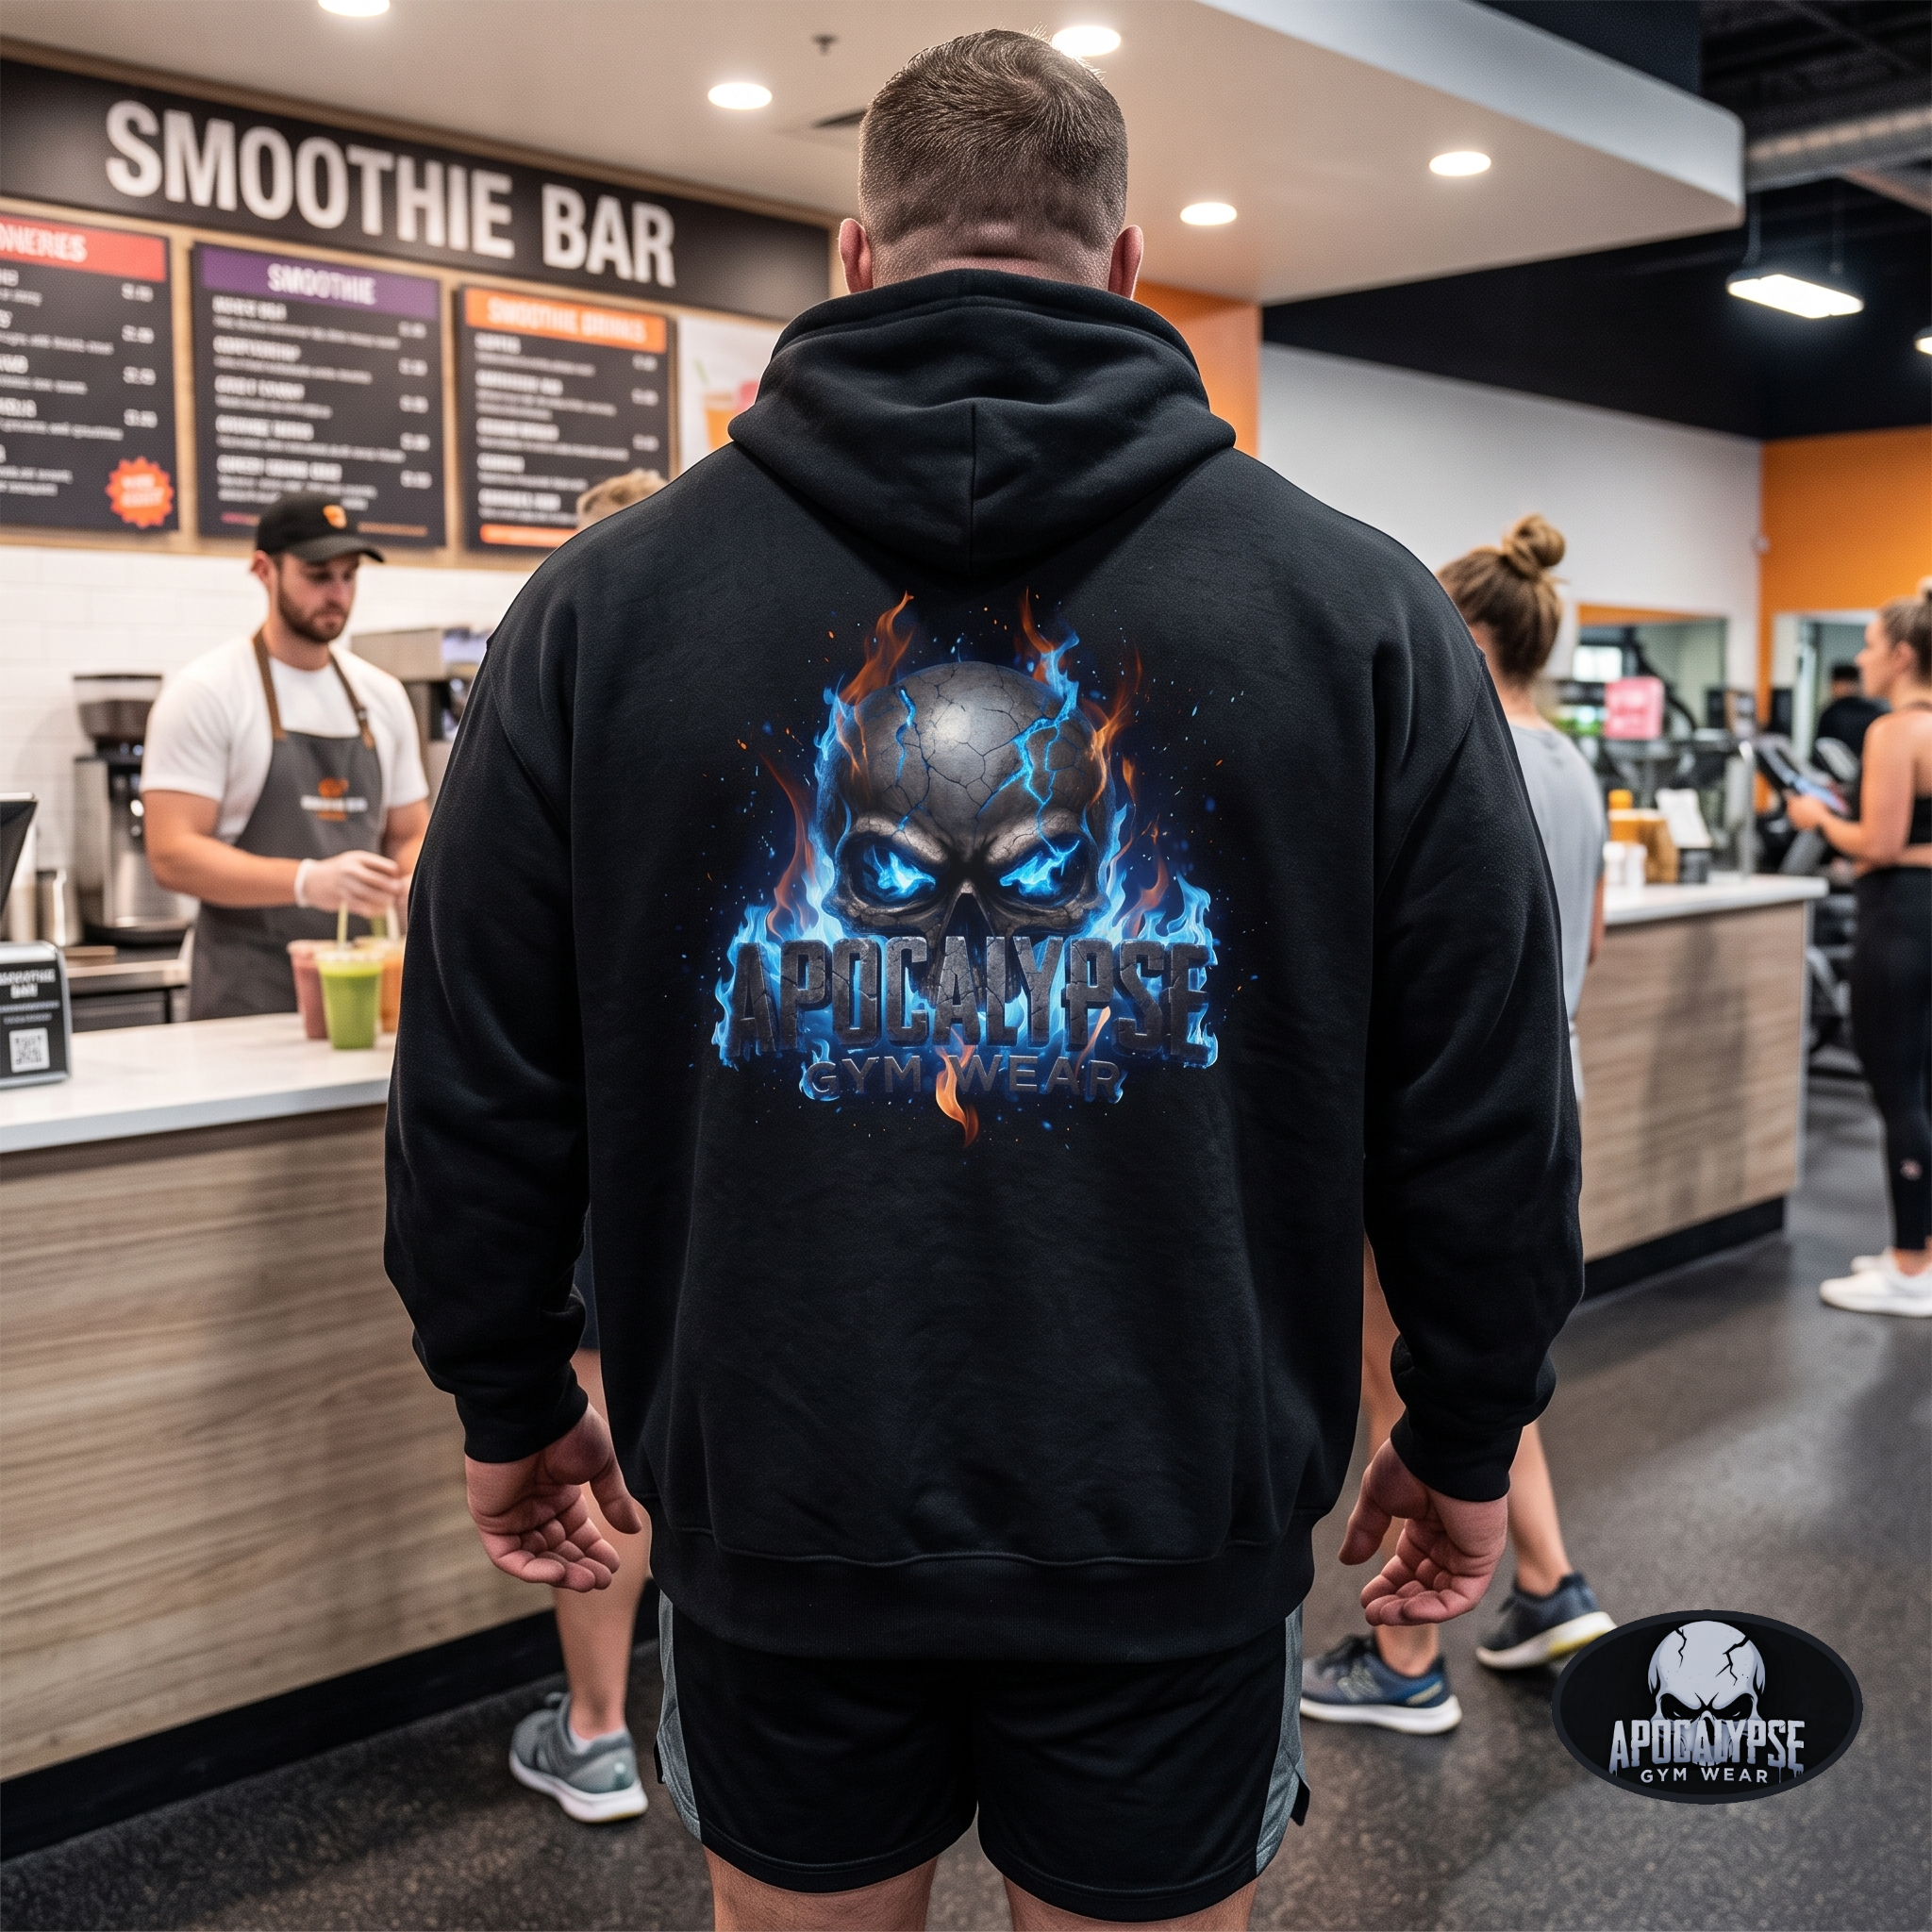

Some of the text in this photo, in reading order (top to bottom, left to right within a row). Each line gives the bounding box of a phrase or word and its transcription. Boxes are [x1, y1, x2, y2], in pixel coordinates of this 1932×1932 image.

[105, 99, 676, 288] SMOOTHIE BAR
[267, 263, 377, 306] SMOOTHIE
[487, 295, 578, 335] SMOOTHIE
[728, 935, 1213, 1065] APOCALYPSE
[805, 1054, 1123, 1100] GYM WEAR
